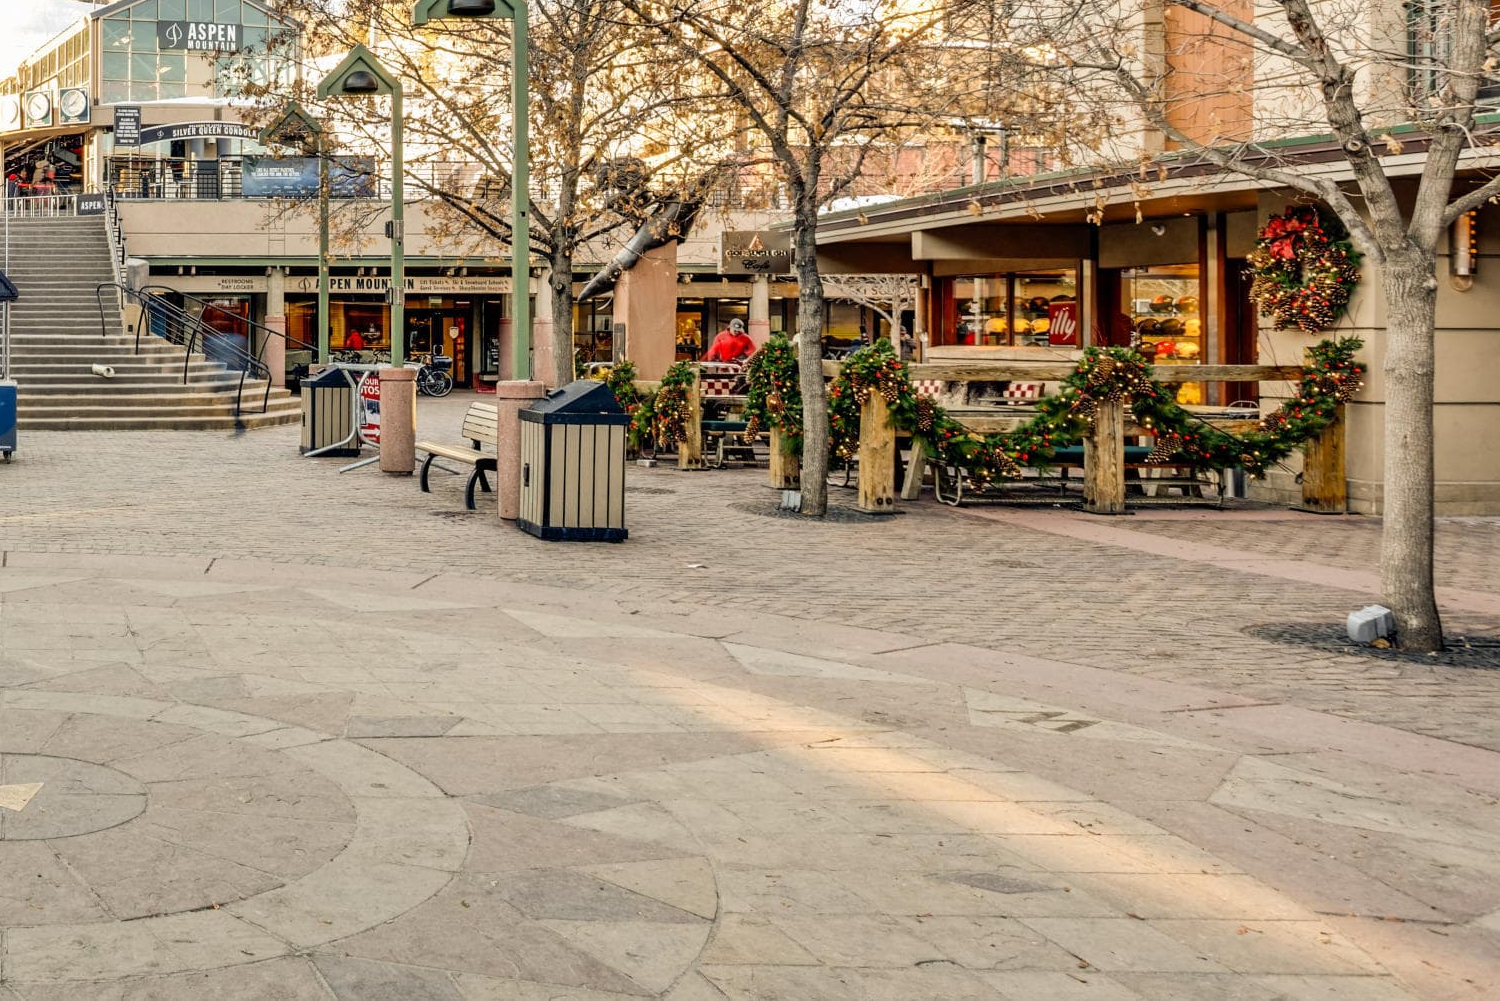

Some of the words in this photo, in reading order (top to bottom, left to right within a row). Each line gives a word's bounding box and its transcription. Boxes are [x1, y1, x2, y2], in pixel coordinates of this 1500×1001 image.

[187, 22, 236, 41] ASPEN
[187, 39, 236, 51] MOUNTAIN
[172, 127, 197, 138] SILVER
[199, 126, 221, 136] QUEEN
[224, 126, 257, 138] GONDOLA
[80, 201, 102, 210] ASPEN
[315, 279, 351, 289] APEN
[356, 279, 414, 289] MOUNIN
[1050, 310, 1076, 341] illy
